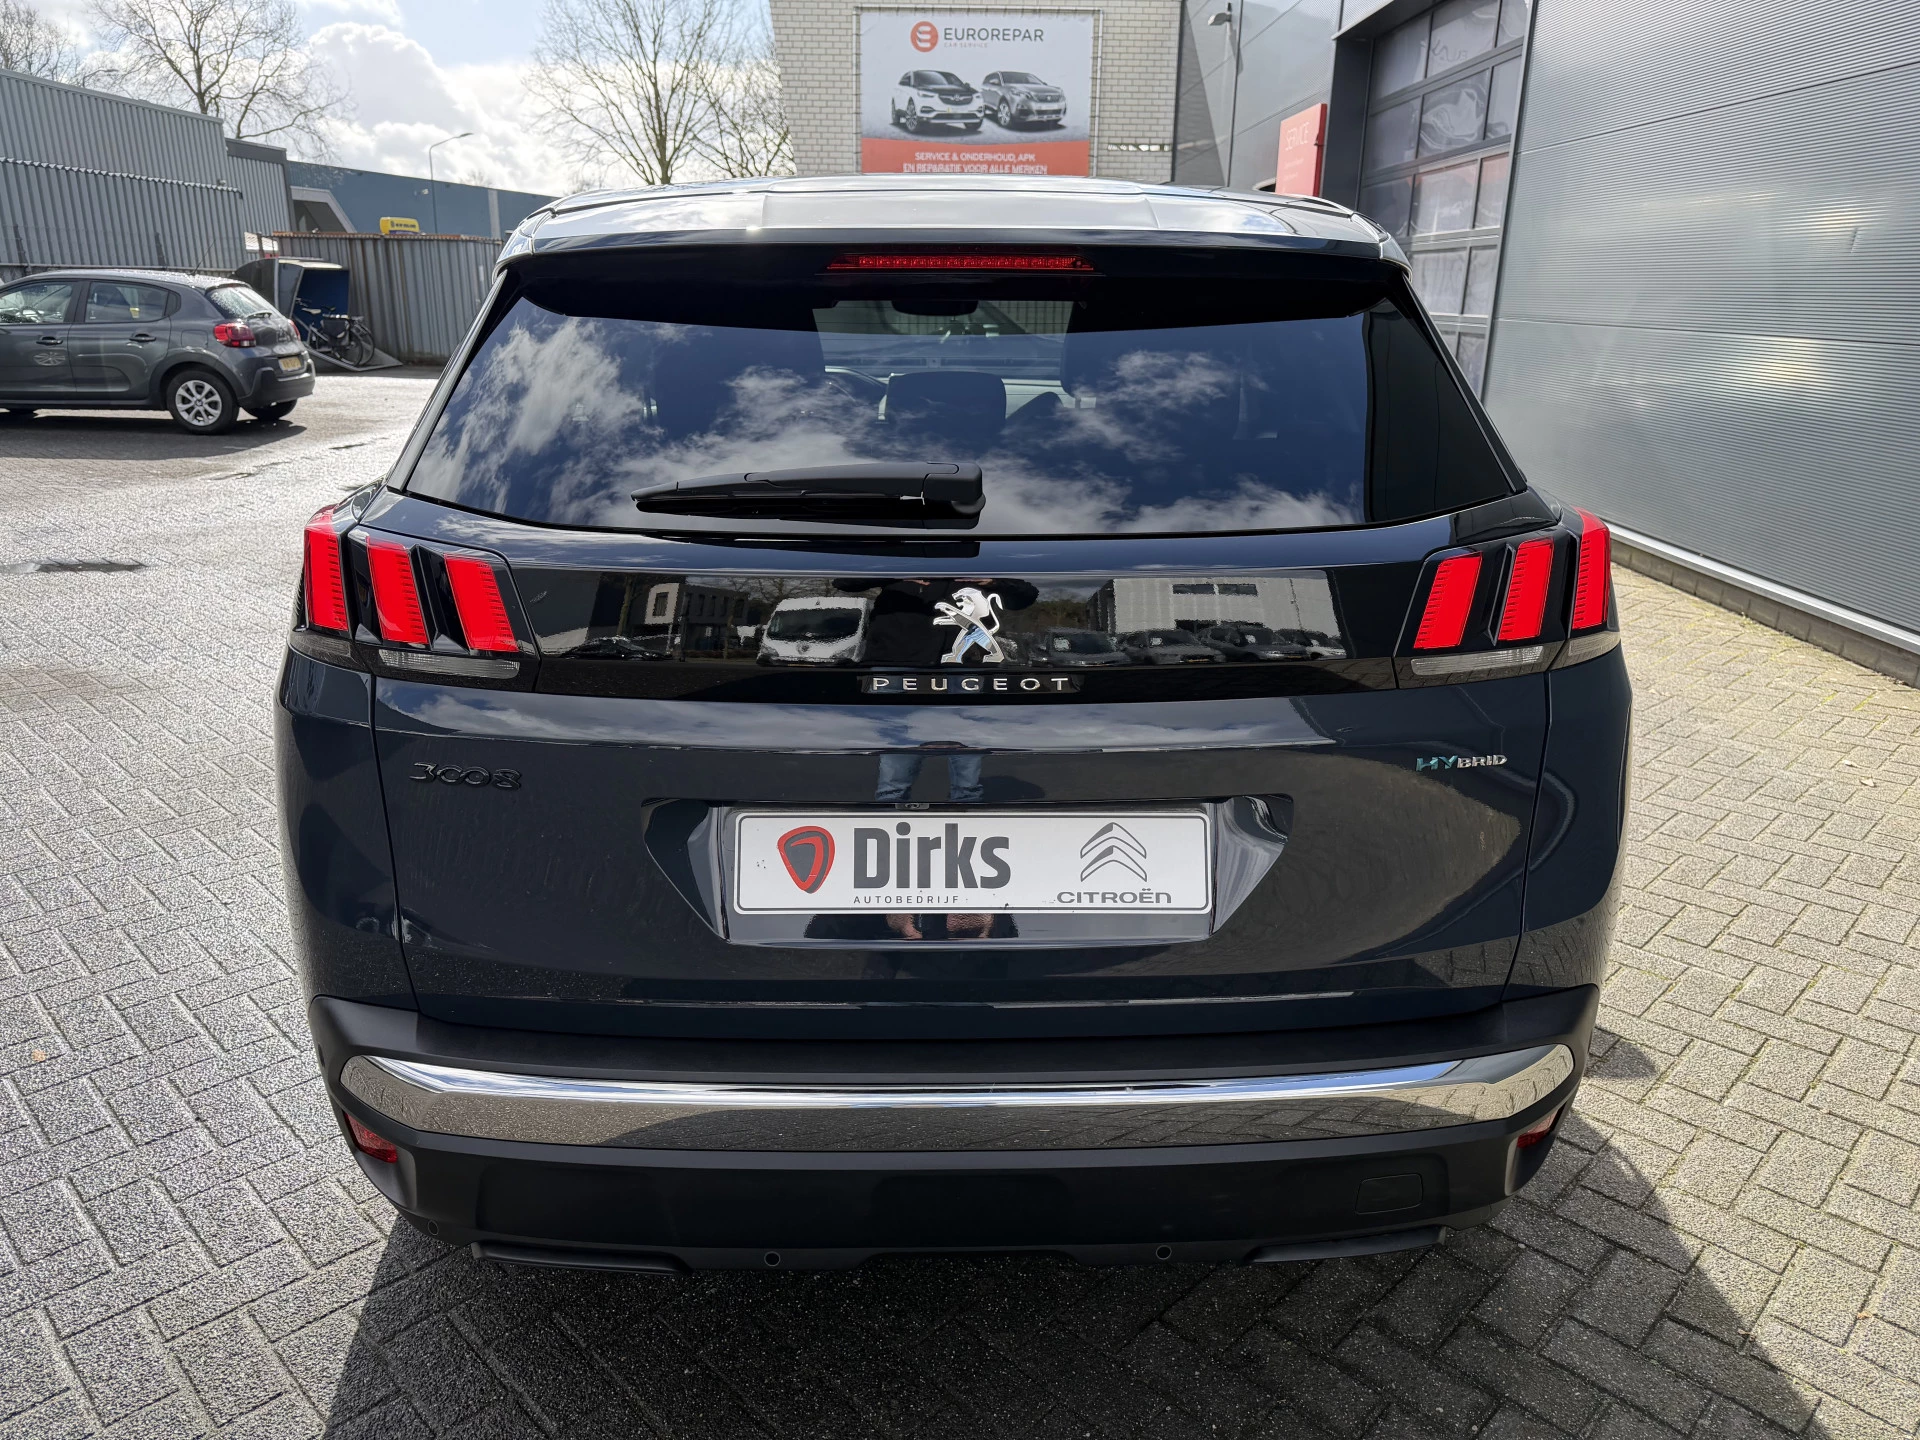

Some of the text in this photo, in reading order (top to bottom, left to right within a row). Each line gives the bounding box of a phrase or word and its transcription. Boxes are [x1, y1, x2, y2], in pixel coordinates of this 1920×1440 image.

[943, 27, 1044, 42] EUROREPAR
[915, 152, 1036, 163] SERVICE & ONDERHOUD, APK
[903, 163, 1047, 175] EN REPARATIE VOOR ALLE MERKEN
[872, 677, 1068, 691] PEUGEOT
[1415, 754, 1508, 772] HYBRID
[409, 762, 521, 790] 3008
[853, 821, 1011, 889] Dirks
[853, 895, 959, 904] AUTOBEDRIJF
